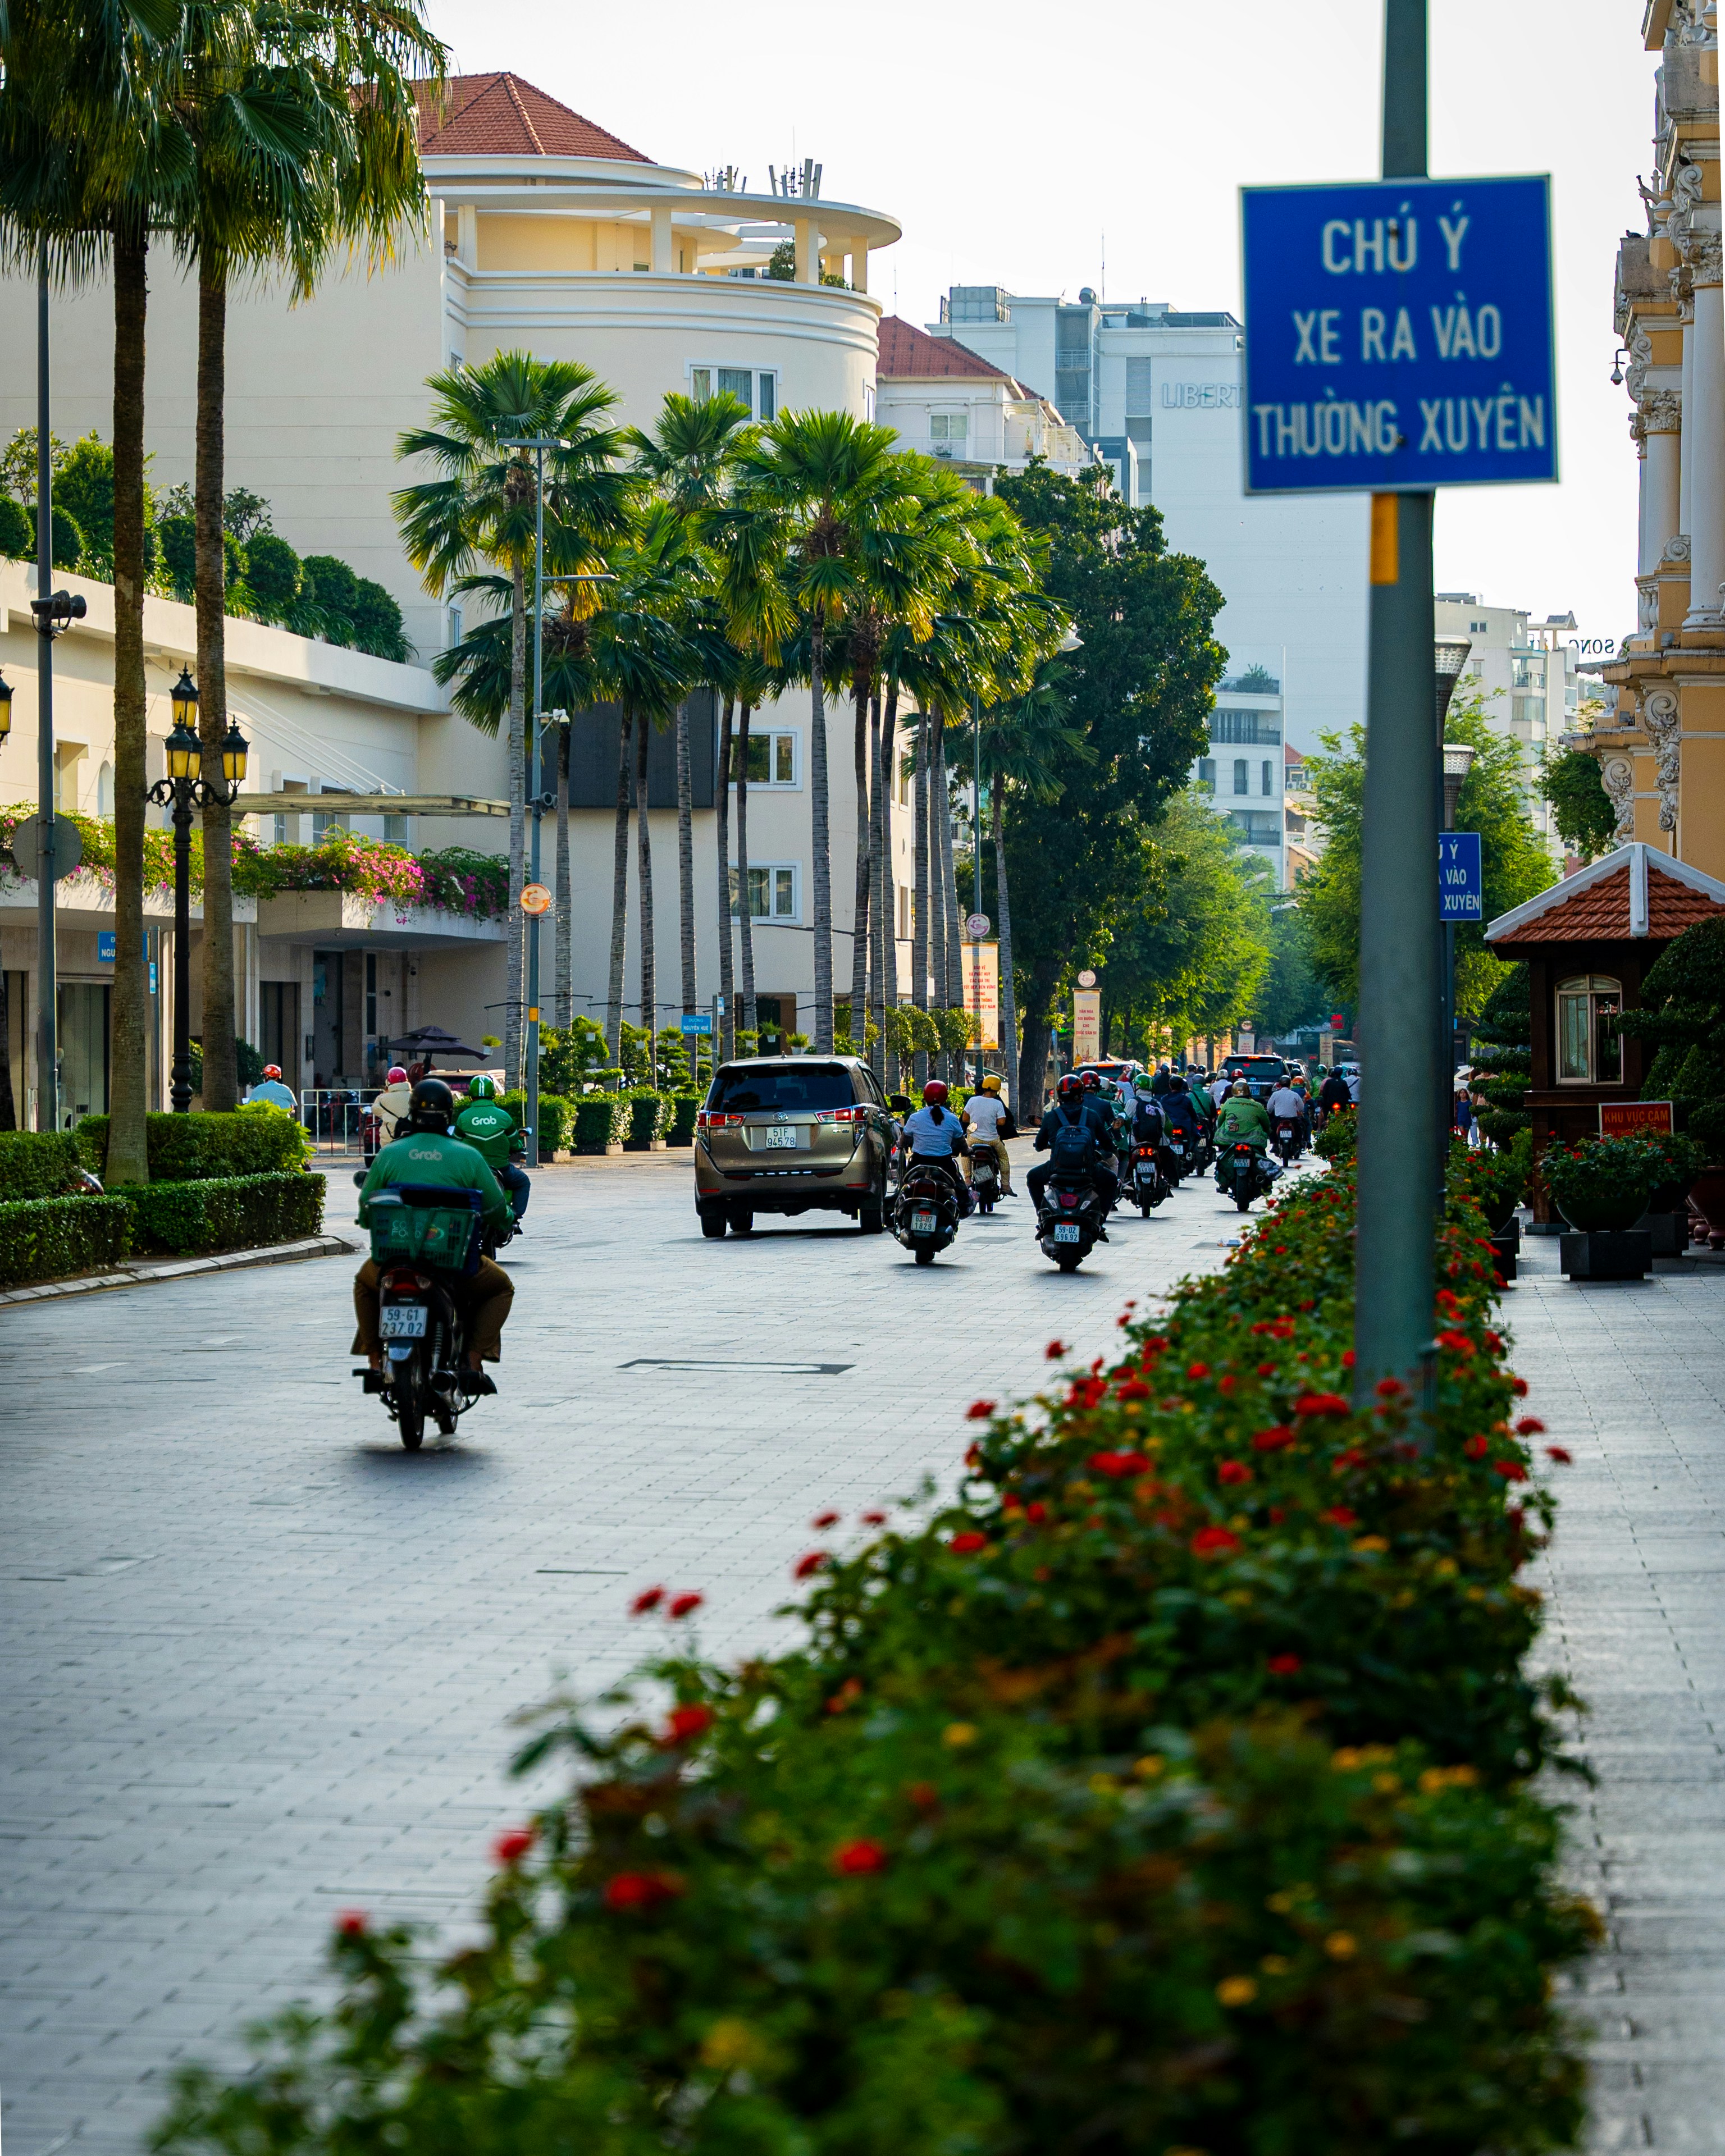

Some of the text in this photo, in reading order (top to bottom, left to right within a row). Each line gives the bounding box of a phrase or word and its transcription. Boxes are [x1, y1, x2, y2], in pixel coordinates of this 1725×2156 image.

[1322, 201, 1469, 273] CHÚ Ý
[1293, 291, 1502, 364] XE RA VÀO
[1419, 383, 1545, 454] XUYÊN
[1449, 839, 1459, 860] Ý
[1446, 865, 1467, 885] VÀO
[1444, 890, 1480, 911] XUYÊN
[472, 1116, 497, 1126] Grab
[1605, 1112, 1623, 1123] KHU
[1648, 1106, 1668, 1122] CẤM
[773, 1128, 788, 1137] 51F
[767, 1138, 795, 1146] 945.78
[408, 1149, 442, 1161] Grab
[391, 1227, 421, 1239] FOD
[387, 1309, 418, 1321] 59-G1
[382, 1322, 422, 1335] 237.02
